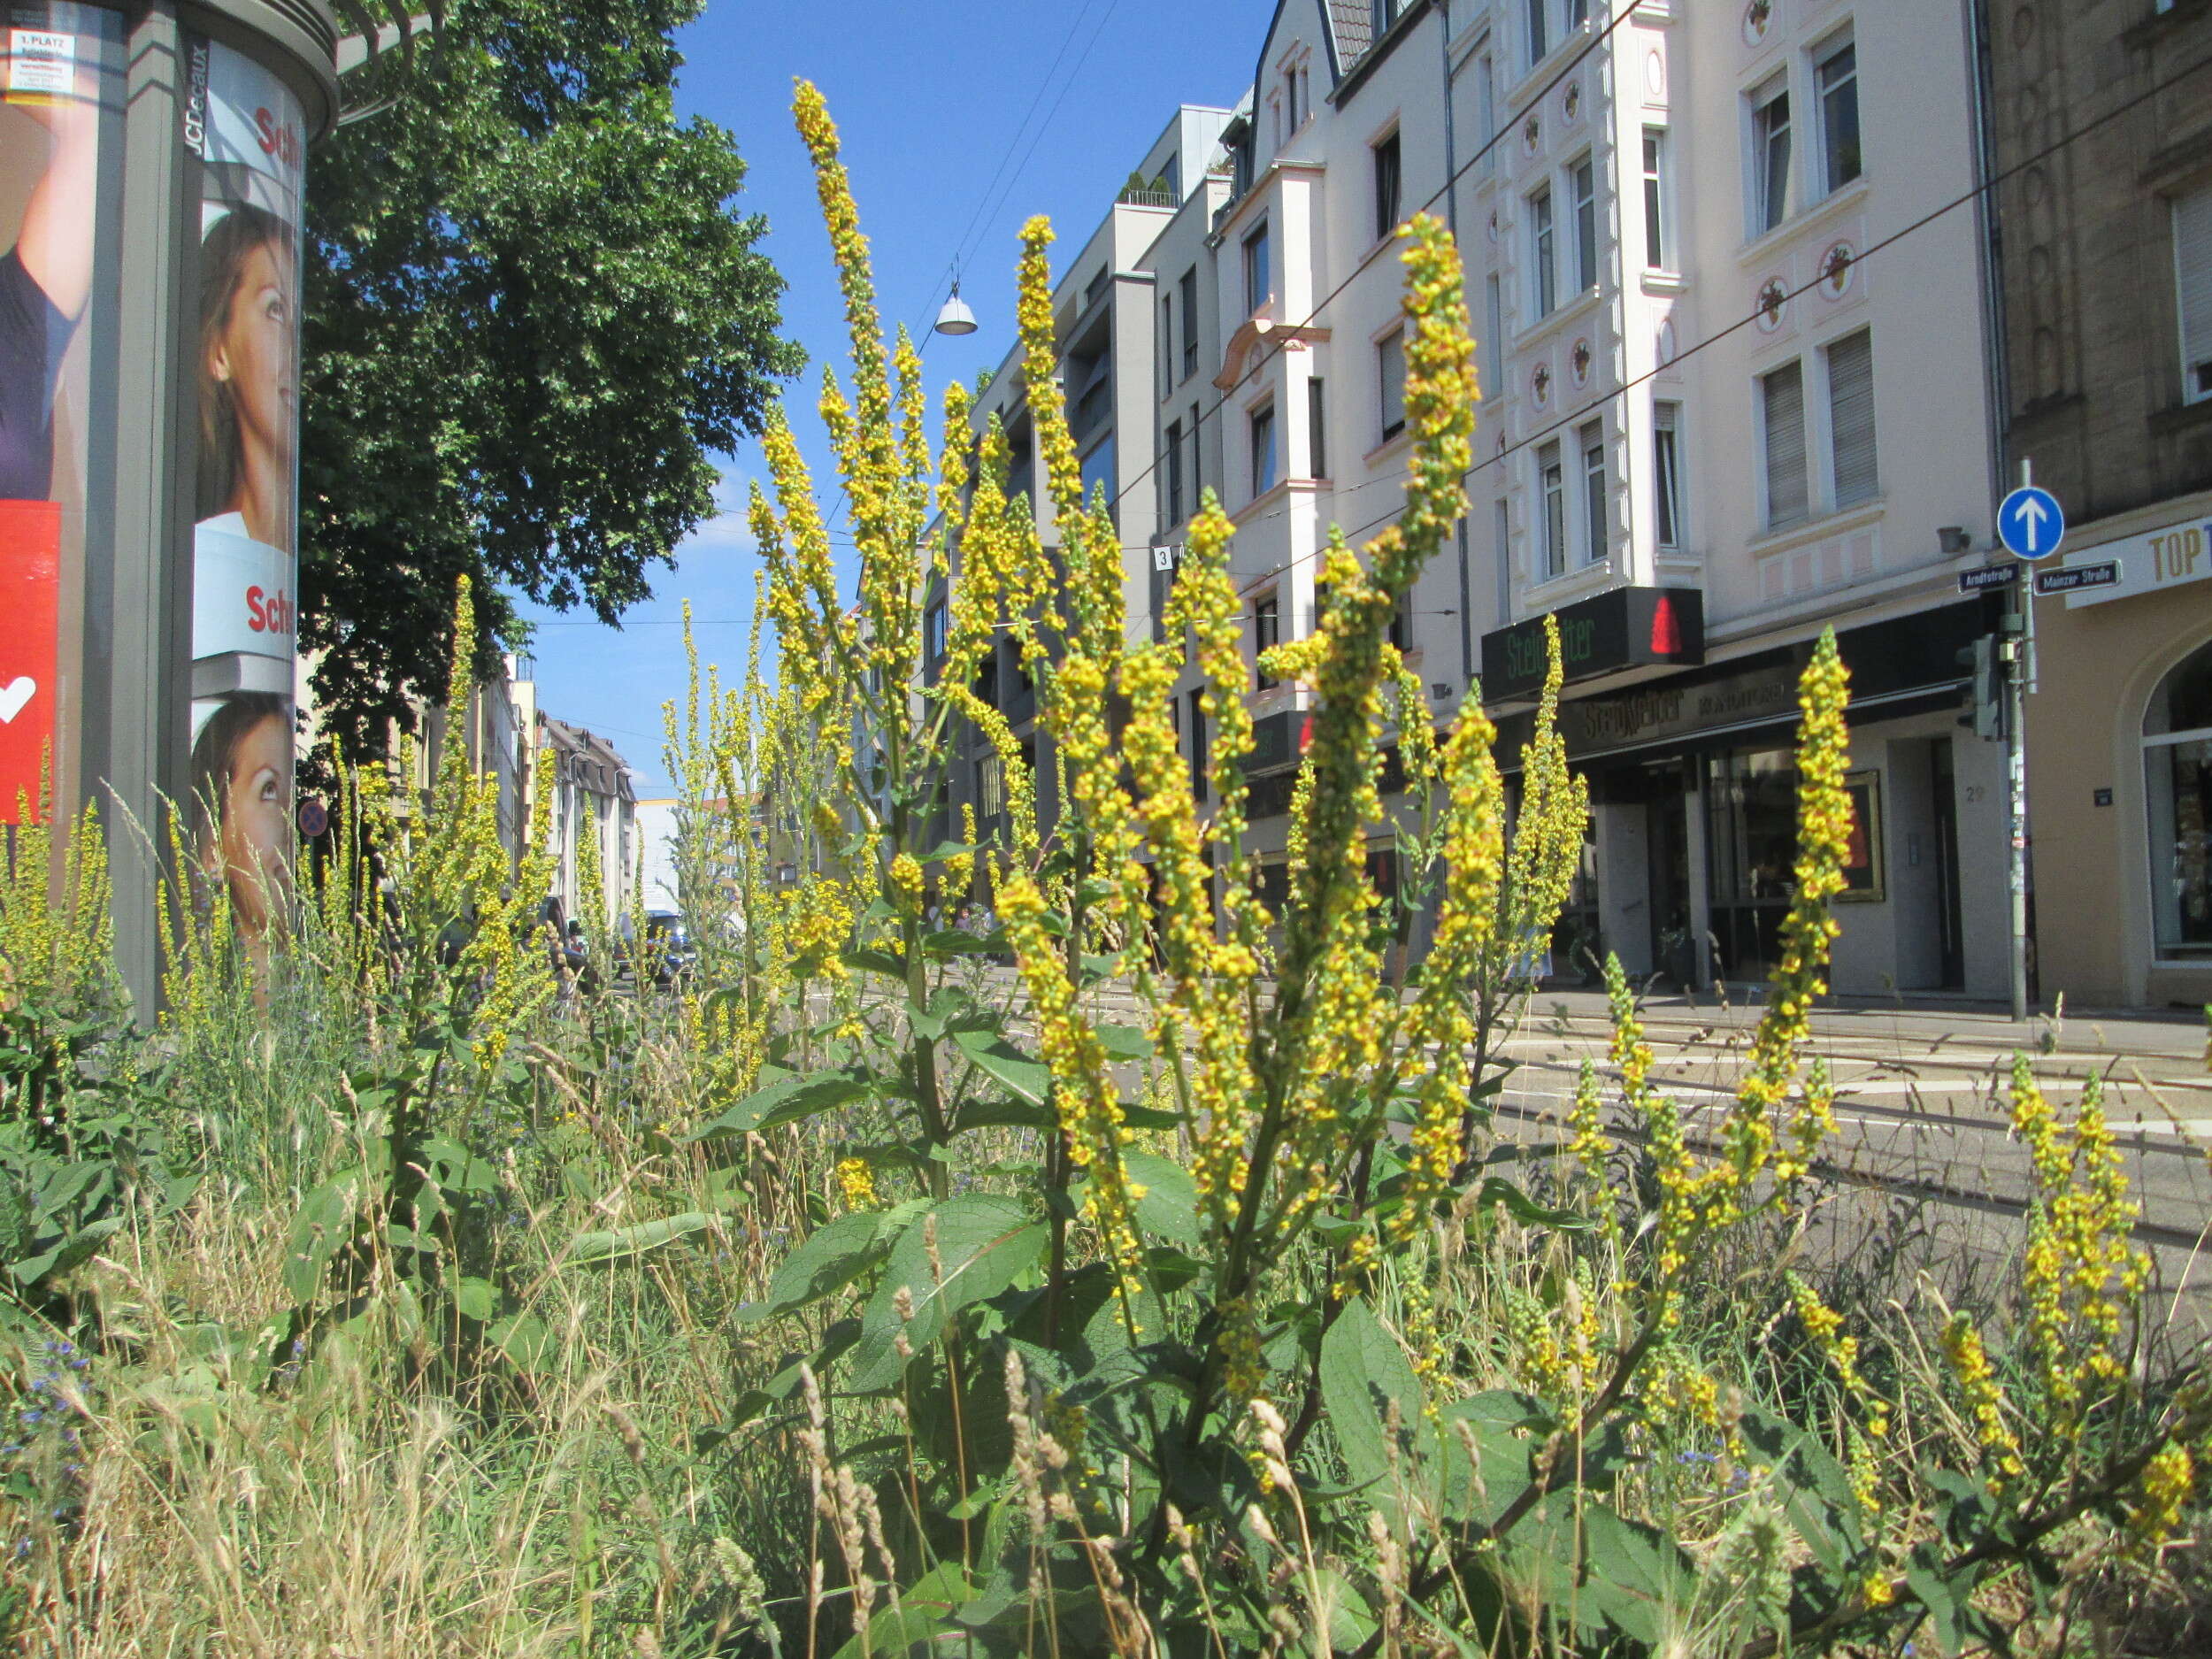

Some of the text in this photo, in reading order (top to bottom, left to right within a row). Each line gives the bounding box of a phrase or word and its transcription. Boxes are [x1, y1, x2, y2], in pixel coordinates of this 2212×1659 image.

[31, 36, 64, 48] PLATZ
[184, 45, 207, 156] JCDecaux
[1159, 550, 1168, 566] 3
[1966, 567, 2013, 587] Arndtstraße
[2043, 567, 2110, 589] Mainzer Straße
